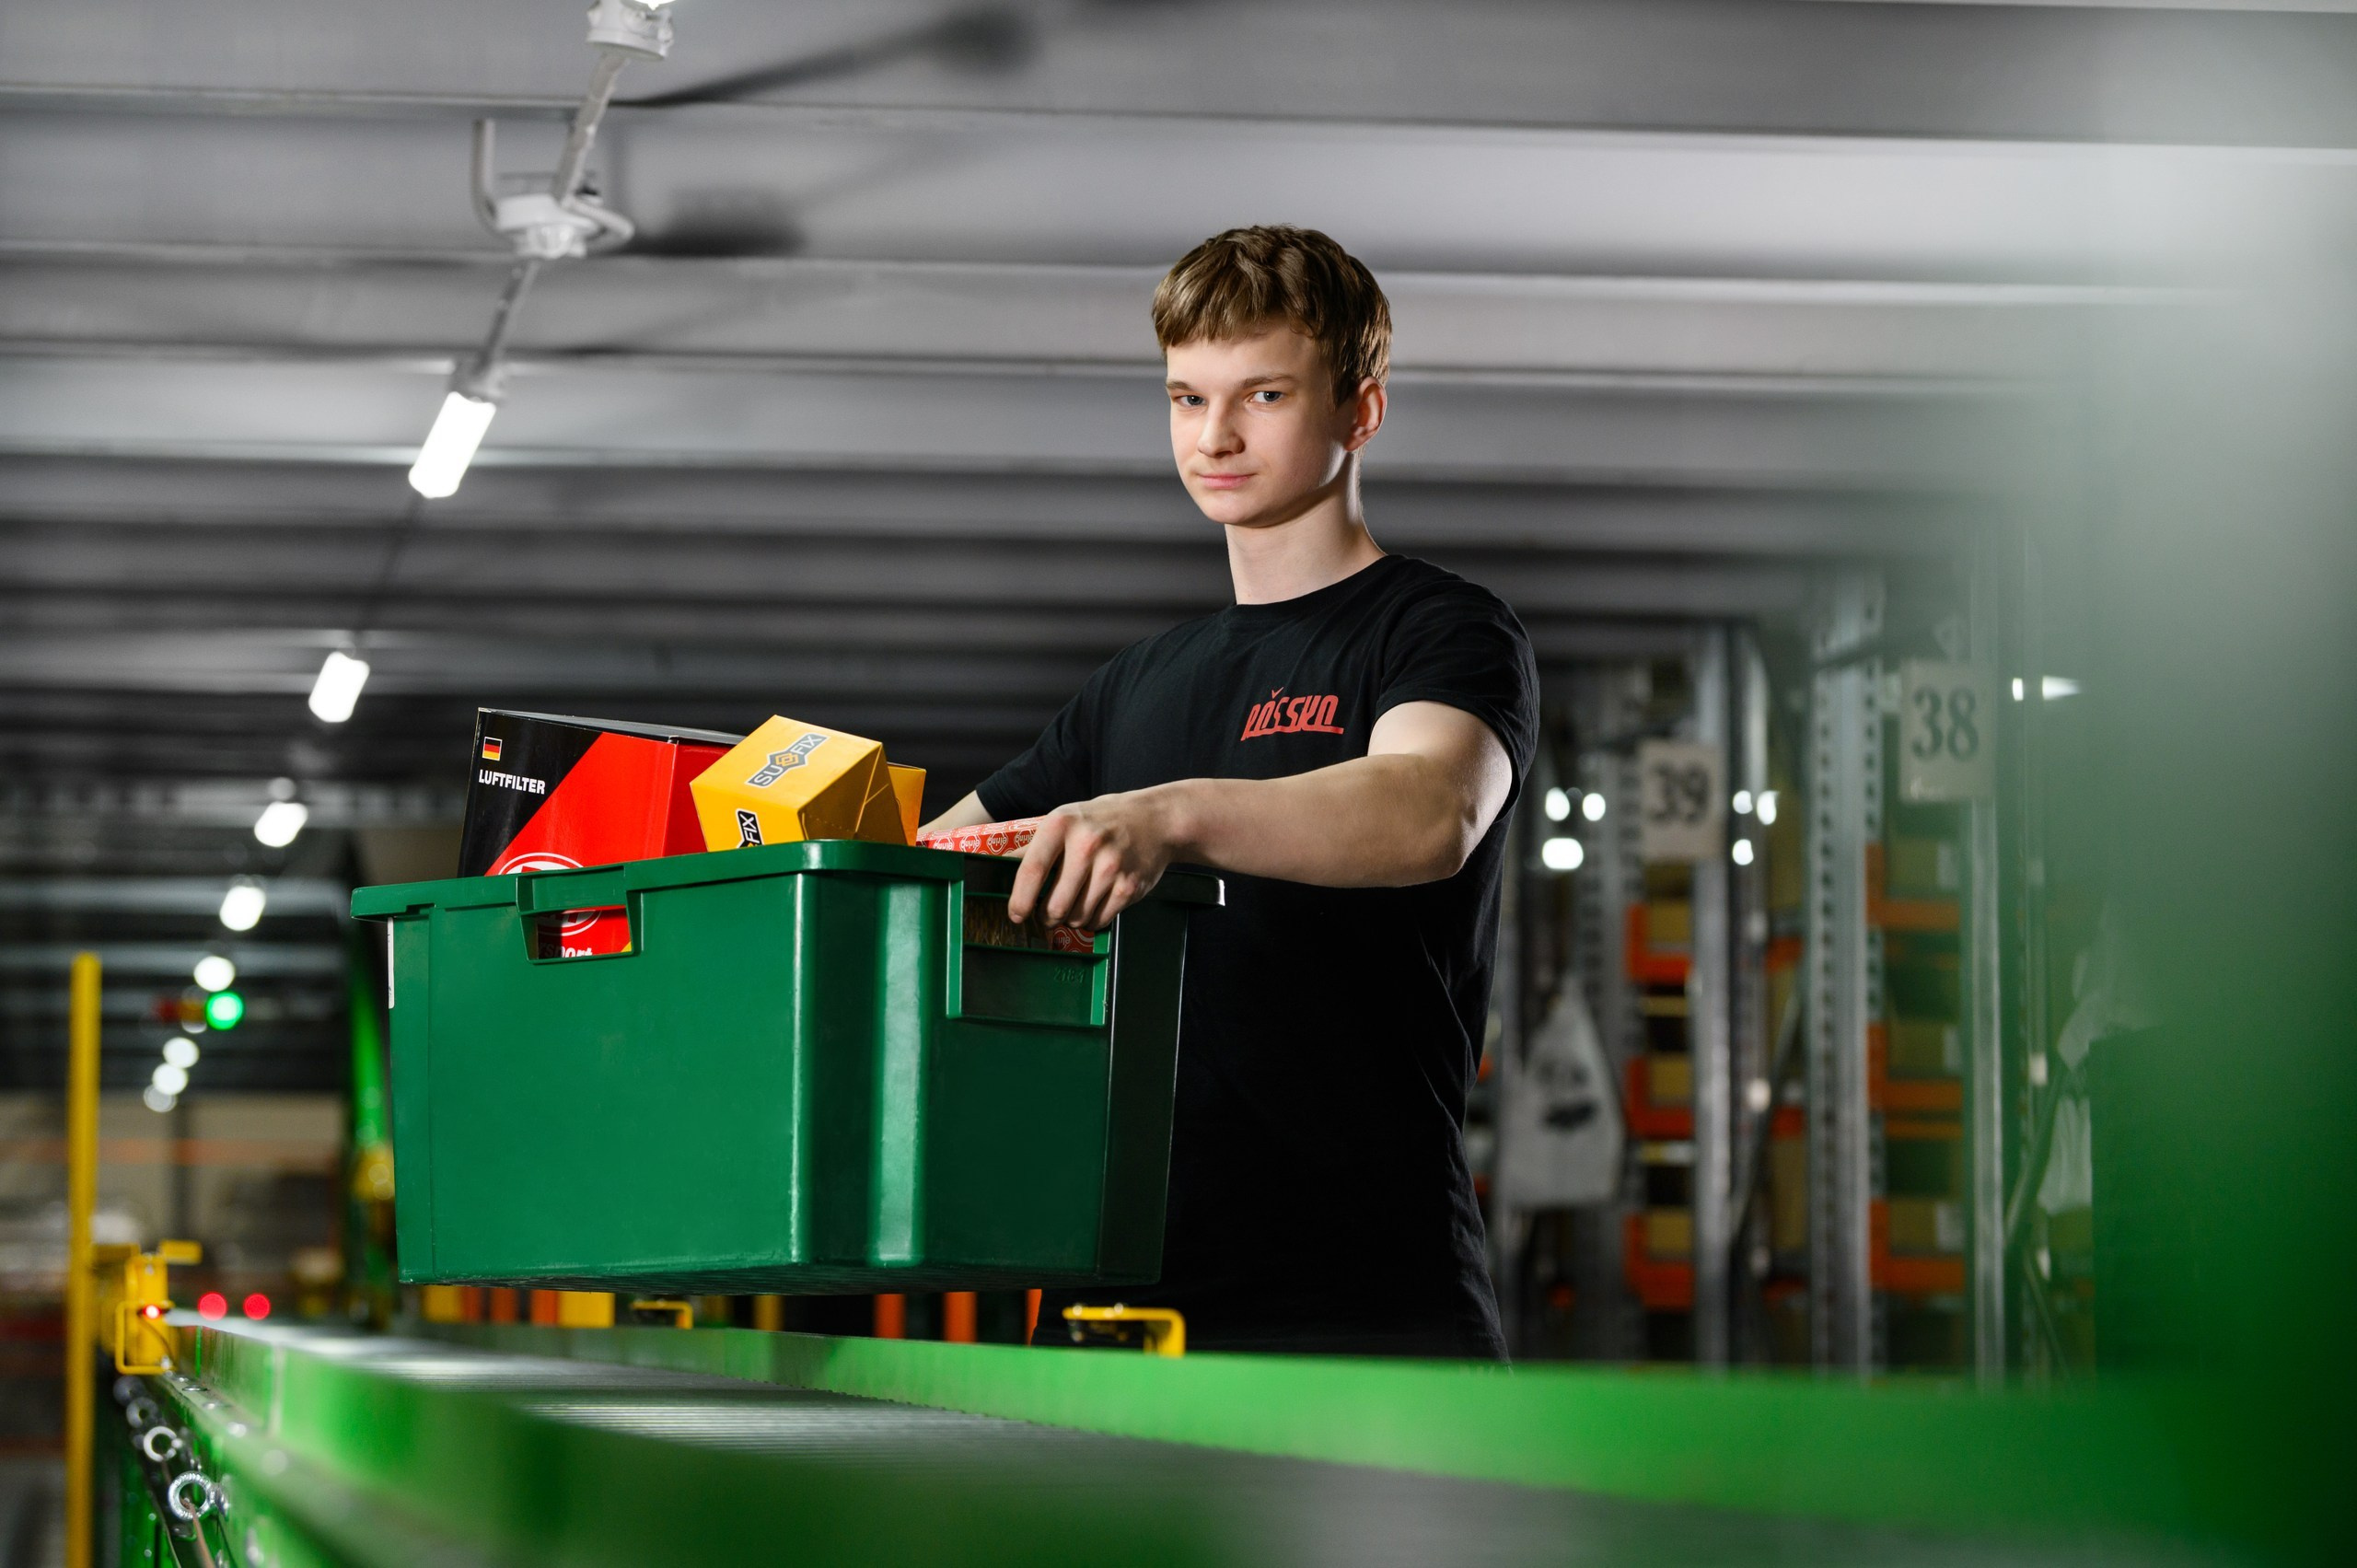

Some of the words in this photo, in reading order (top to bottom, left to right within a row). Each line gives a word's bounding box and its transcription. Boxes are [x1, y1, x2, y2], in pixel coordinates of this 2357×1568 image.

[1910, 686, 1980, 761] 38
[478, 769, 546, 795] LUFTFILTER
[1651, 761, 1711, 826] 39
